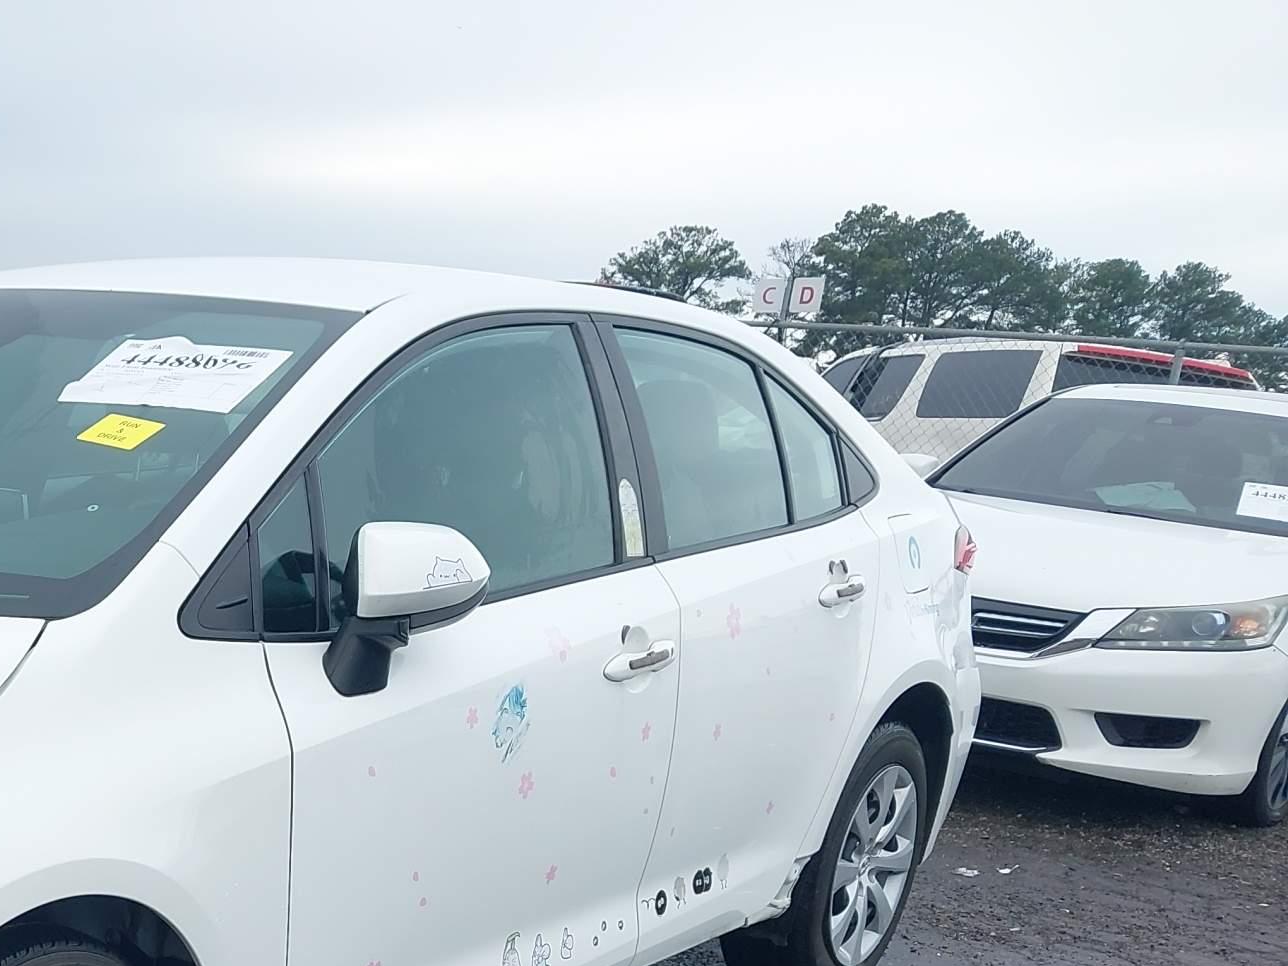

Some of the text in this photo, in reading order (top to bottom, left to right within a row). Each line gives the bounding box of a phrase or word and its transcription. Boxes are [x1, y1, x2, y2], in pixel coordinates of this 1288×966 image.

[762, 287, 777, 304] C
[799, 287, 814, 304] D
[119, 420, 142, 429] RUN
[97, 432, 127, 442] DRIVE
[1251, 491, 1288, 500] 4448
